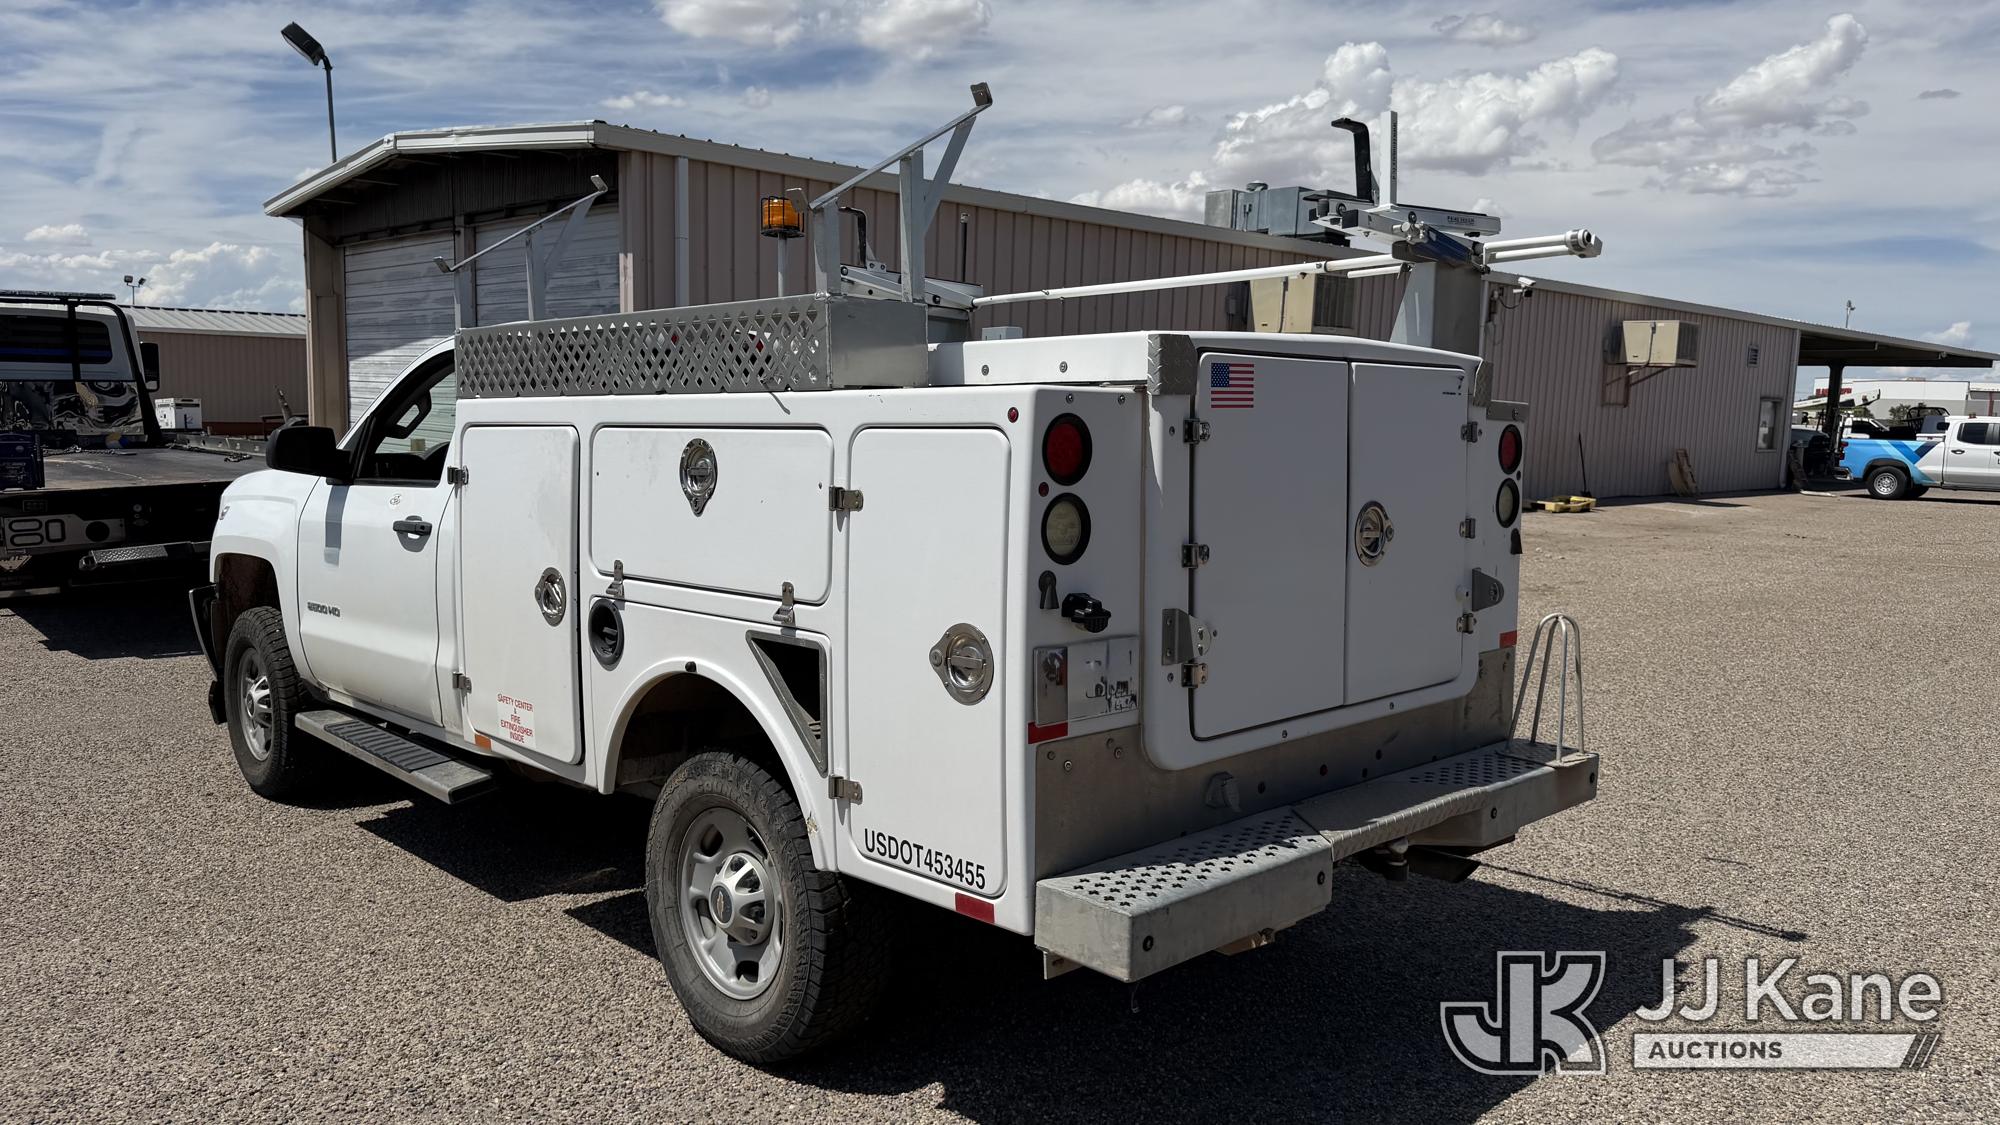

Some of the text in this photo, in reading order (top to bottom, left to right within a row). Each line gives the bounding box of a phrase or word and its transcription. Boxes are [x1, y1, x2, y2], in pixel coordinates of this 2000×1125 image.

[497, 693, 514, 706] SAFETY
[514, 699, 533, 712] CENTER
[864, 828, 986, 889] USDOT453455
